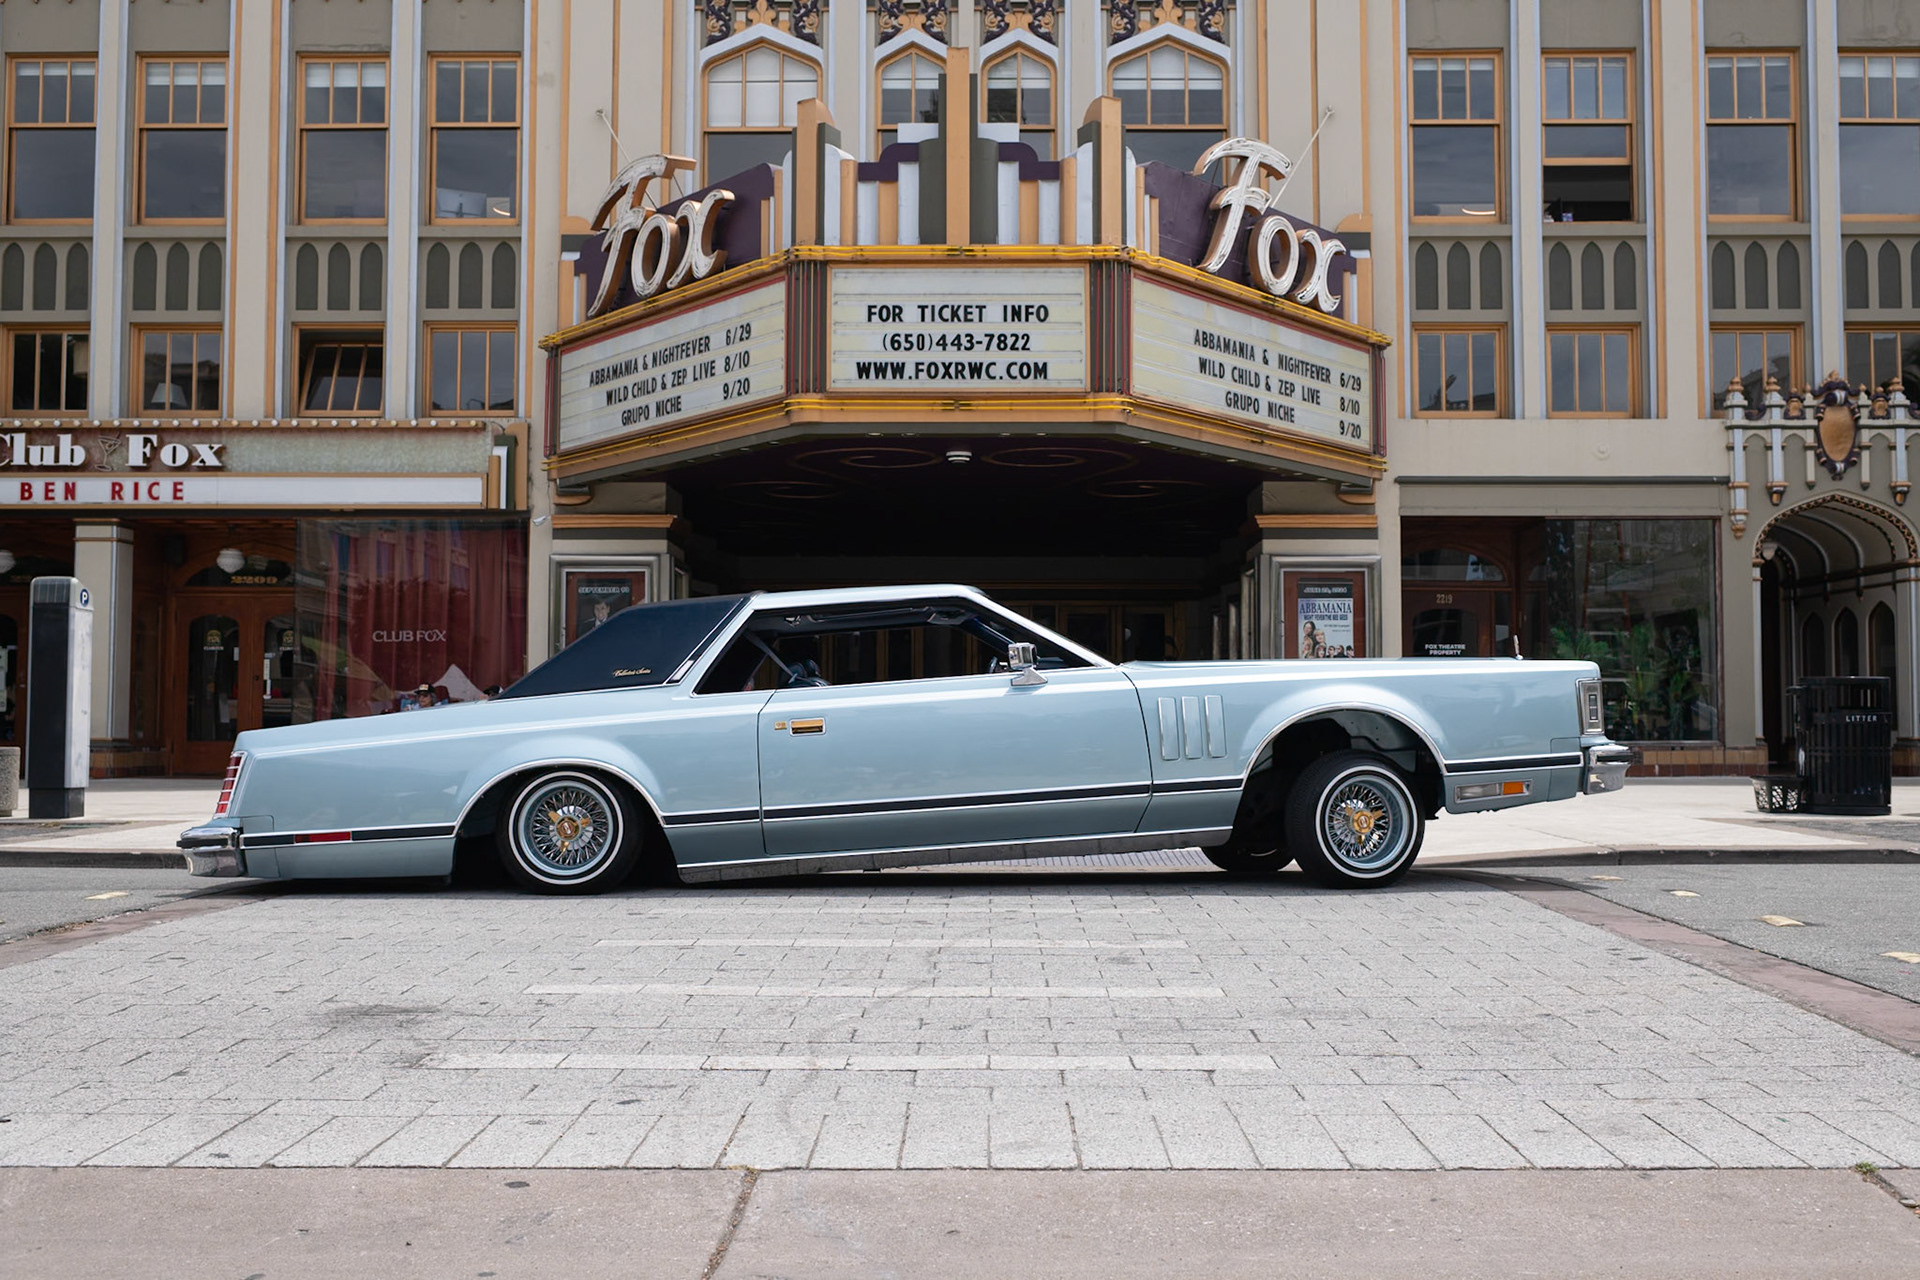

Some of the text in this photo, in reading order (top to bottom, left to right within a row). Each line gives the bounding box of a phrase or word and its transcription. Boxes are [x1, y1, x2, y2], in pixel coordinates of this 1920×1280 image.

[587, 154, 736, 318] Fox
[1193, 137, 1347, 313] Fox
[867, 304, 1049, 323] FOR TICKET INFO
[589, 323, 752, 388] ABBAMANIA & NIGHTFEVER 6/29
[882, 333, 1031, 352] (650)443-7822
[1194, 329, 1362, 392] ABBAMANIA & NIGHTFEVER 6/29
[606, 350, 750, 406] WILD CHILD & ZEP LIVE 8/10
[856, 362, 1049, 380] WWW.FOXRWC.COM
[1199, 356, 1361, 415] WILD CHILD & ZEP LIVE 8/10
[621, 378, 751, 426] GRUPO NICHE 9/20
[1225, 391, 1362, 439] GRUPO NICHE 9/20
[125, 433, 223, 467] Fox
[20, 482, 184, 501] BEN RICE
[1299, 602, 1352, 614] ABBAMANIA
[1436, 593, 1453, 604] 2219
[372, 629, 447, 642] CLUB FOX
